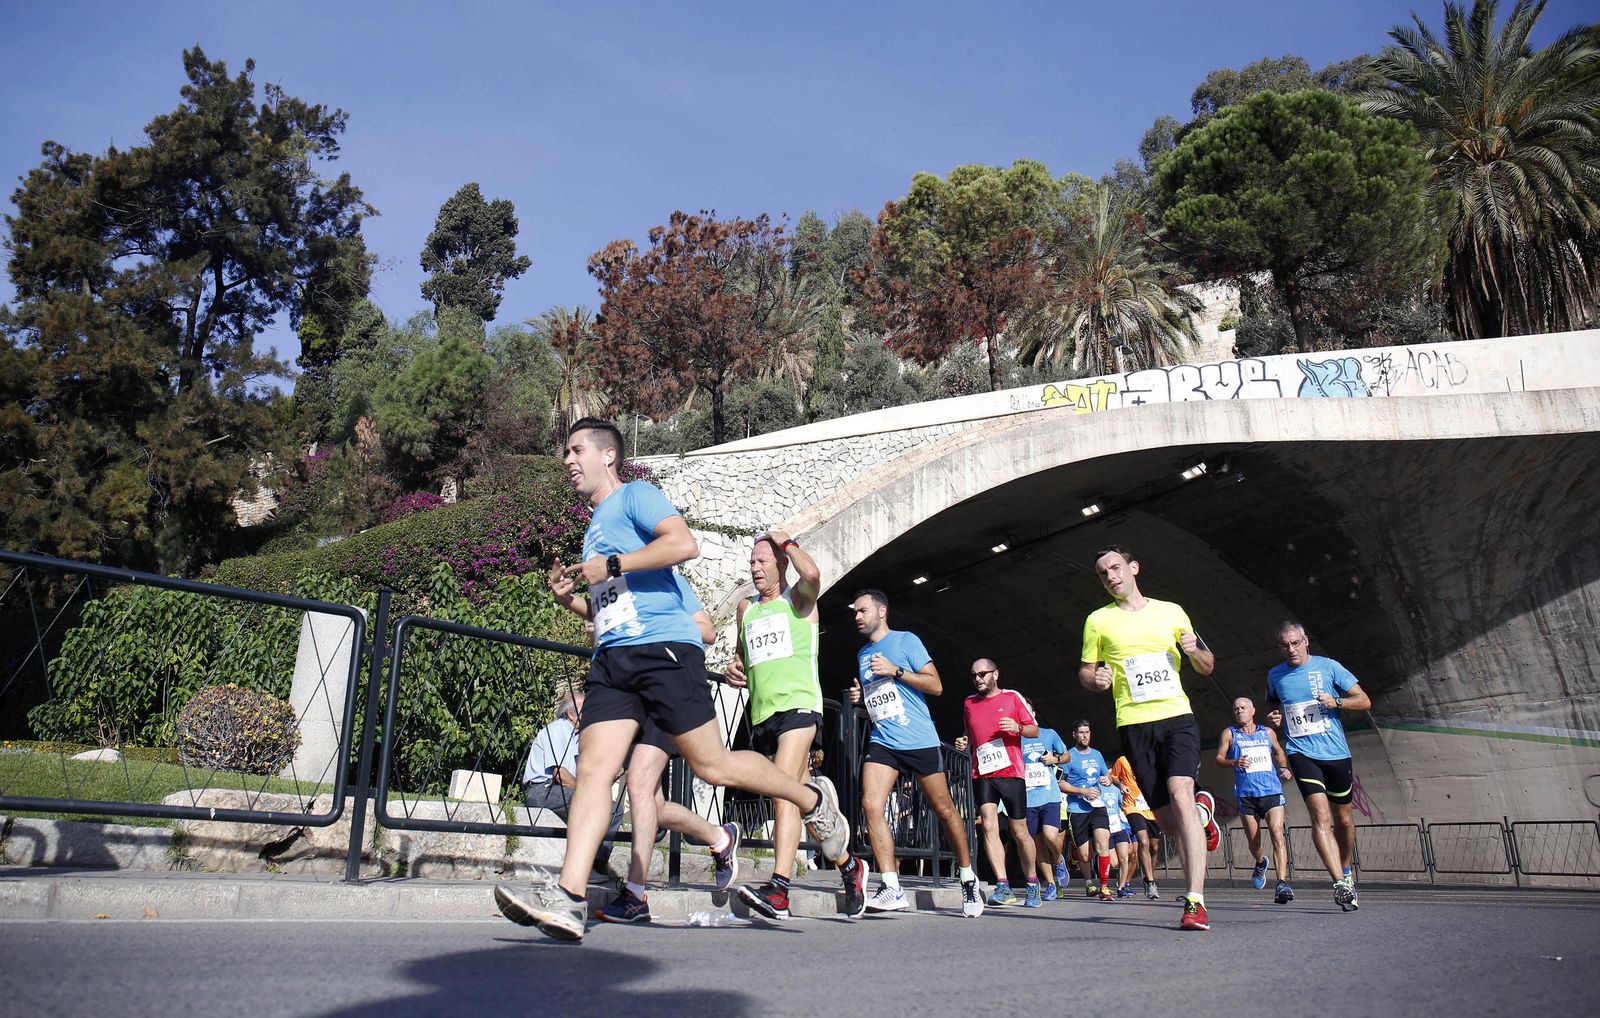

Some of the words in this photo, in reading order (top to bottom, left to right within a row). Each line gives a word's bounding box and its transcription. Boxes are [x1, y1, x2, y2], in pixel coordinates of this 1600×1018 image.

[1405, 347, 1469, 389] ACAB
[749, 630, 786, 650] 13737
[1135, 669, 1171, 687] 2582
[867, 691, 897, 709] 15399
[1291, 713, 1315, 727] 1817
[981, 750, 1003, 765] 2510
[1027, 768, 1046, 779] 8392
